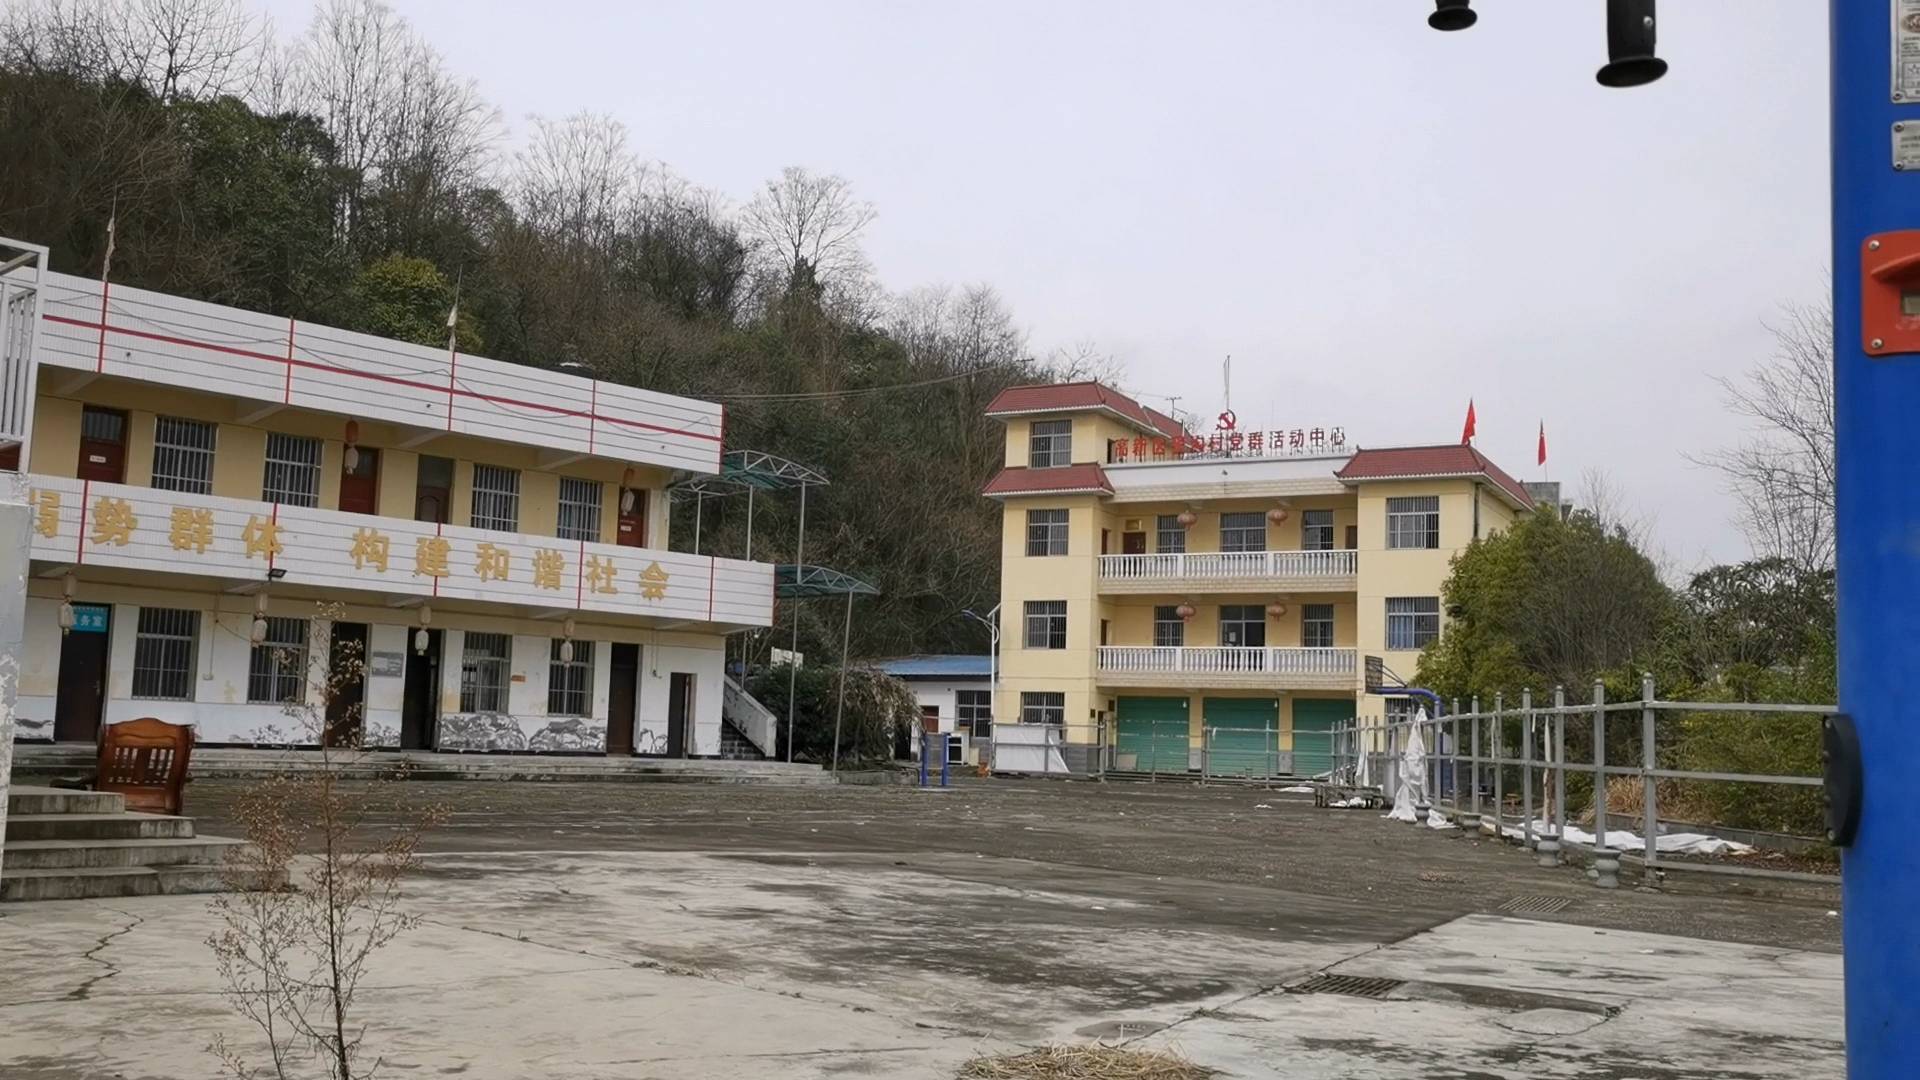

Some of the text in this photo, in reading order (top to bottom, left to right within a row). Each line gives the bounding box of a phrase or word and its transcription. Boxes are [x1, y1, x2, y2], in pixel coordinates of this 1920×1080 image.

[350, 527, 670, 601] 构建和谐社会
